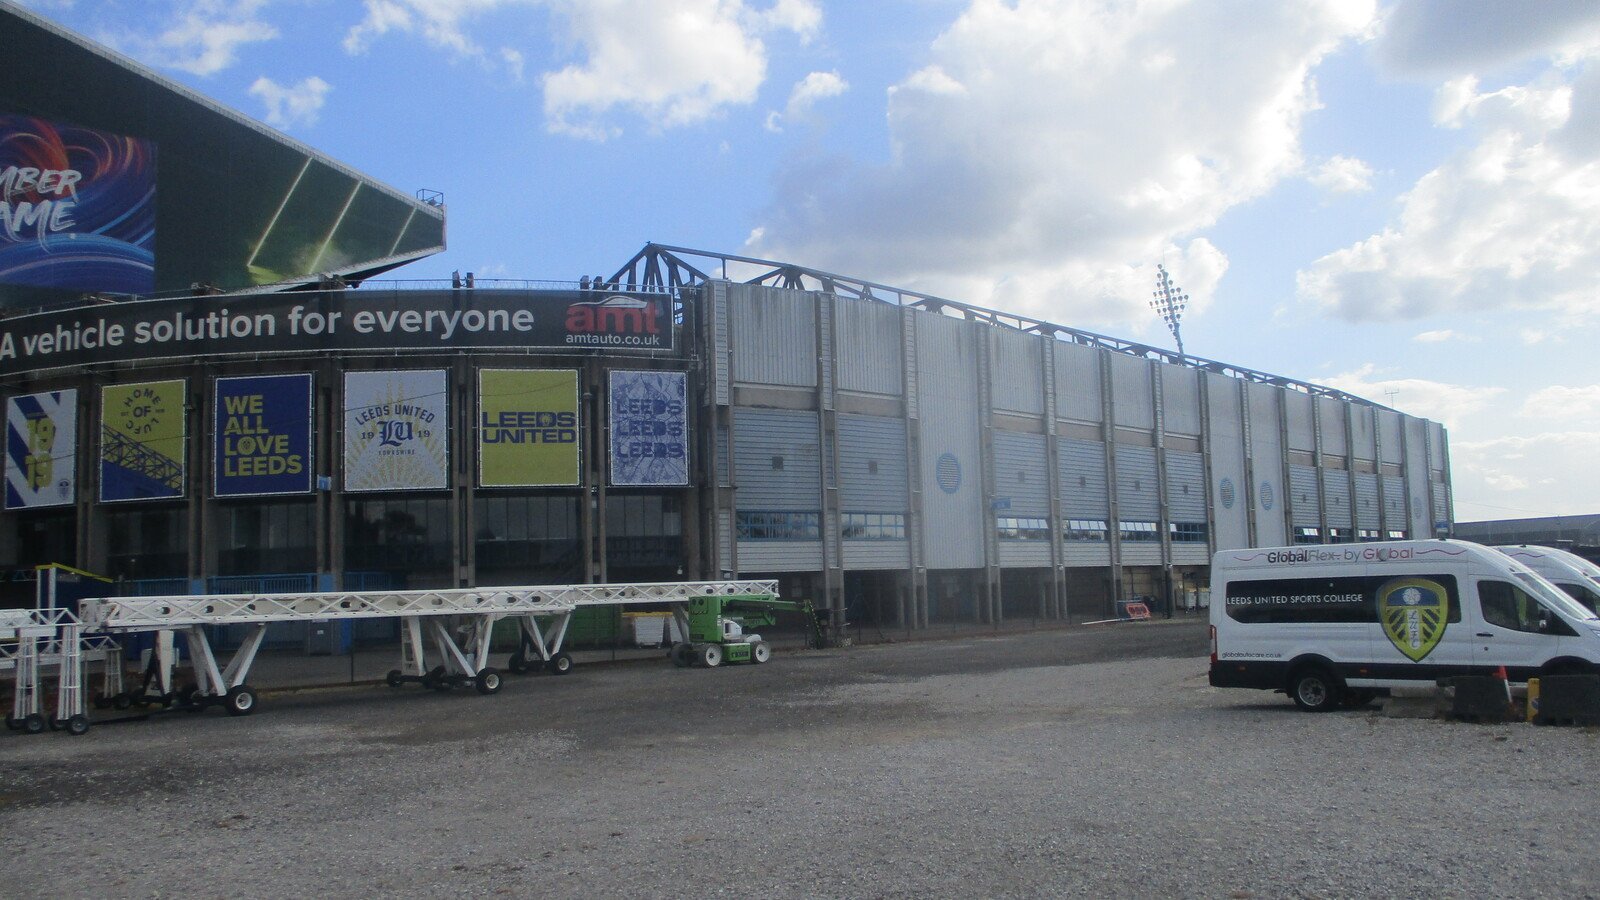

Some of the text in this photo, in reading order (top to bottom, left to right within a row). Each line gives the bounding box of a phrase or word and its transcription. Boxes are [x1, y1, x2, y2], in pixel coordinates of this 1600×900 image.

[565, 301, 660, 333] amt
[0, 305, 535, 360] A vehicle solution for everyone
[566, 334, 660, 346] amtauto.co.uk
[123, 388, 161, 407] HOME
[224, 395, 264, 415] WE
[133, 406, 152, 418] OF
[355, 404, 435, 425] LEEDS UNITED
[482, 411, 576, 428] LEEDS
[224, 416, 269, 435] ALL
[361, 432, 375, 440] 19
[417, 430, 431, 438] 19
[224, 435, 289, 456] LOVE
[482, 428, 576, 444] UNITED
[224, 455, 303, 477] LEEDS
[1344, 549, 1361, 563] by
[1363, 547, 1414, 562] Global
[1226, 593, 1363, 605] LEEDS UNITED SPORTS COLLEGE
